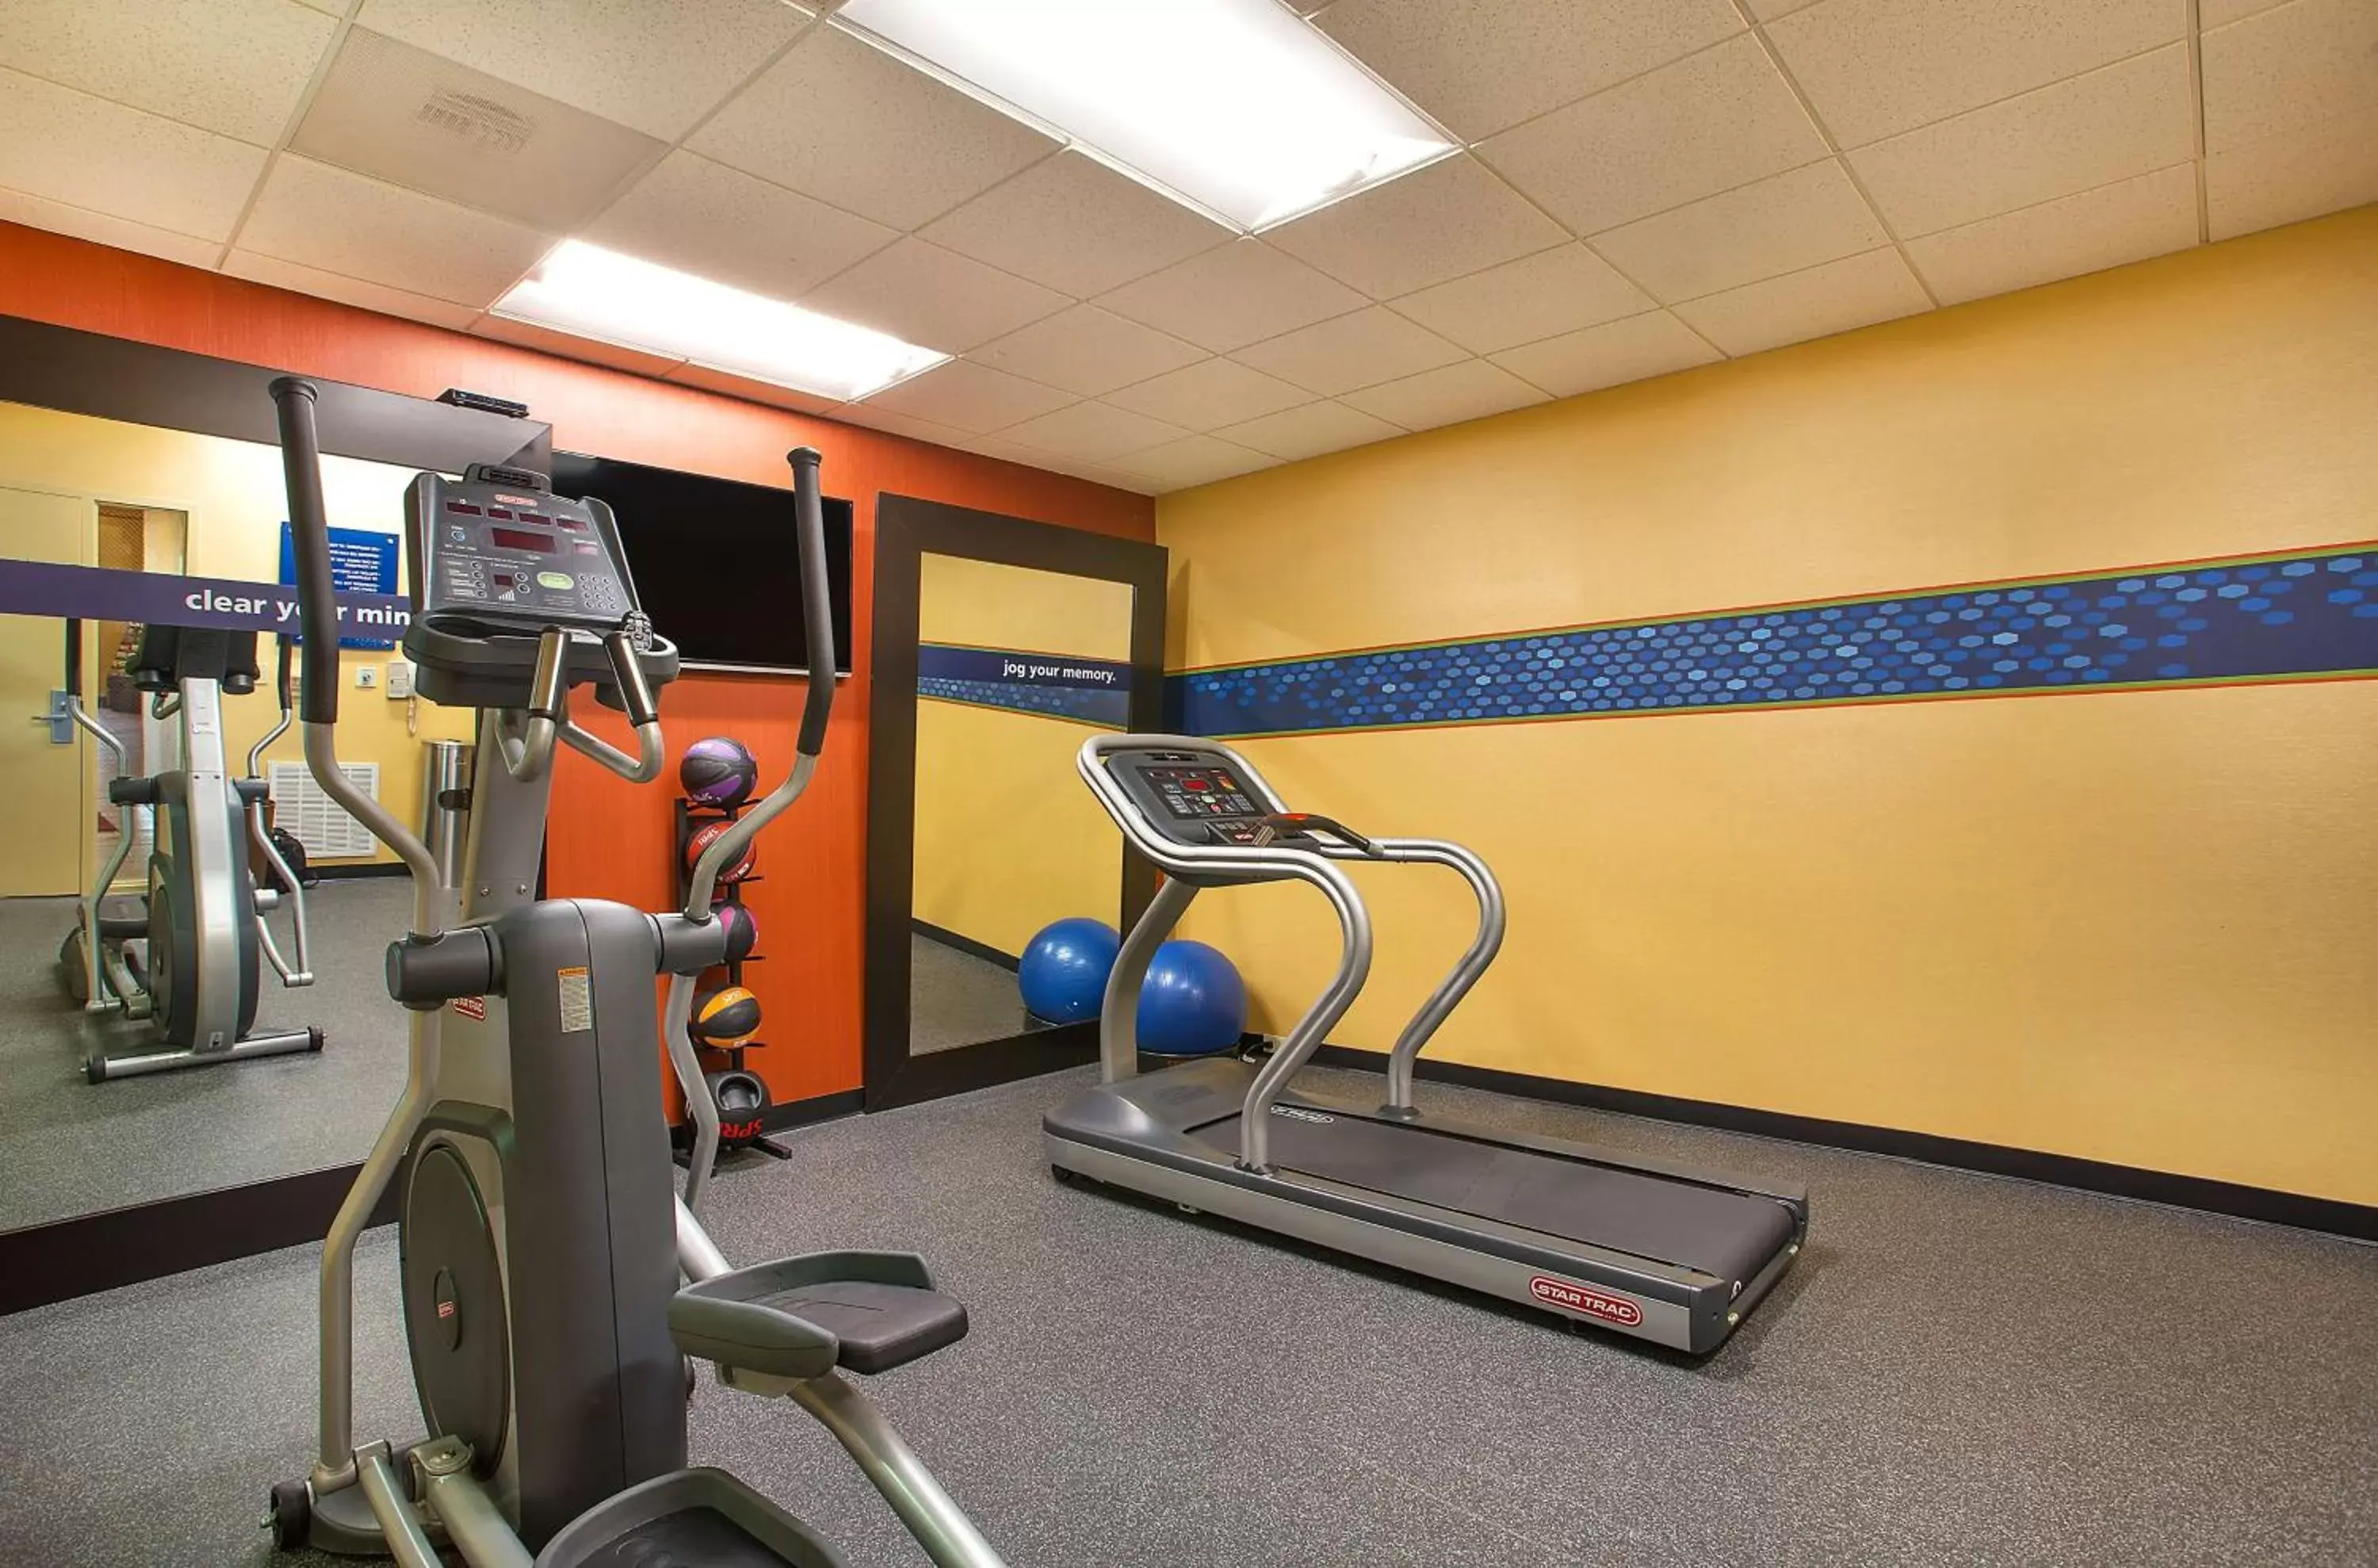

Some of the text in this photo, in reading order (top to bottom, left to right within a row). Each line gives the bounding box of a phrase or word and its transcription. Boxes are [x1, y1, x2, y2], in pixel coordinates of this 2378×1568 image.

[185, 589, 411, 625] clear yr min
[1003, 660, 1116, 683] jog your memory.
[1535, 1284, 1632, 1318] STAR TRAC
